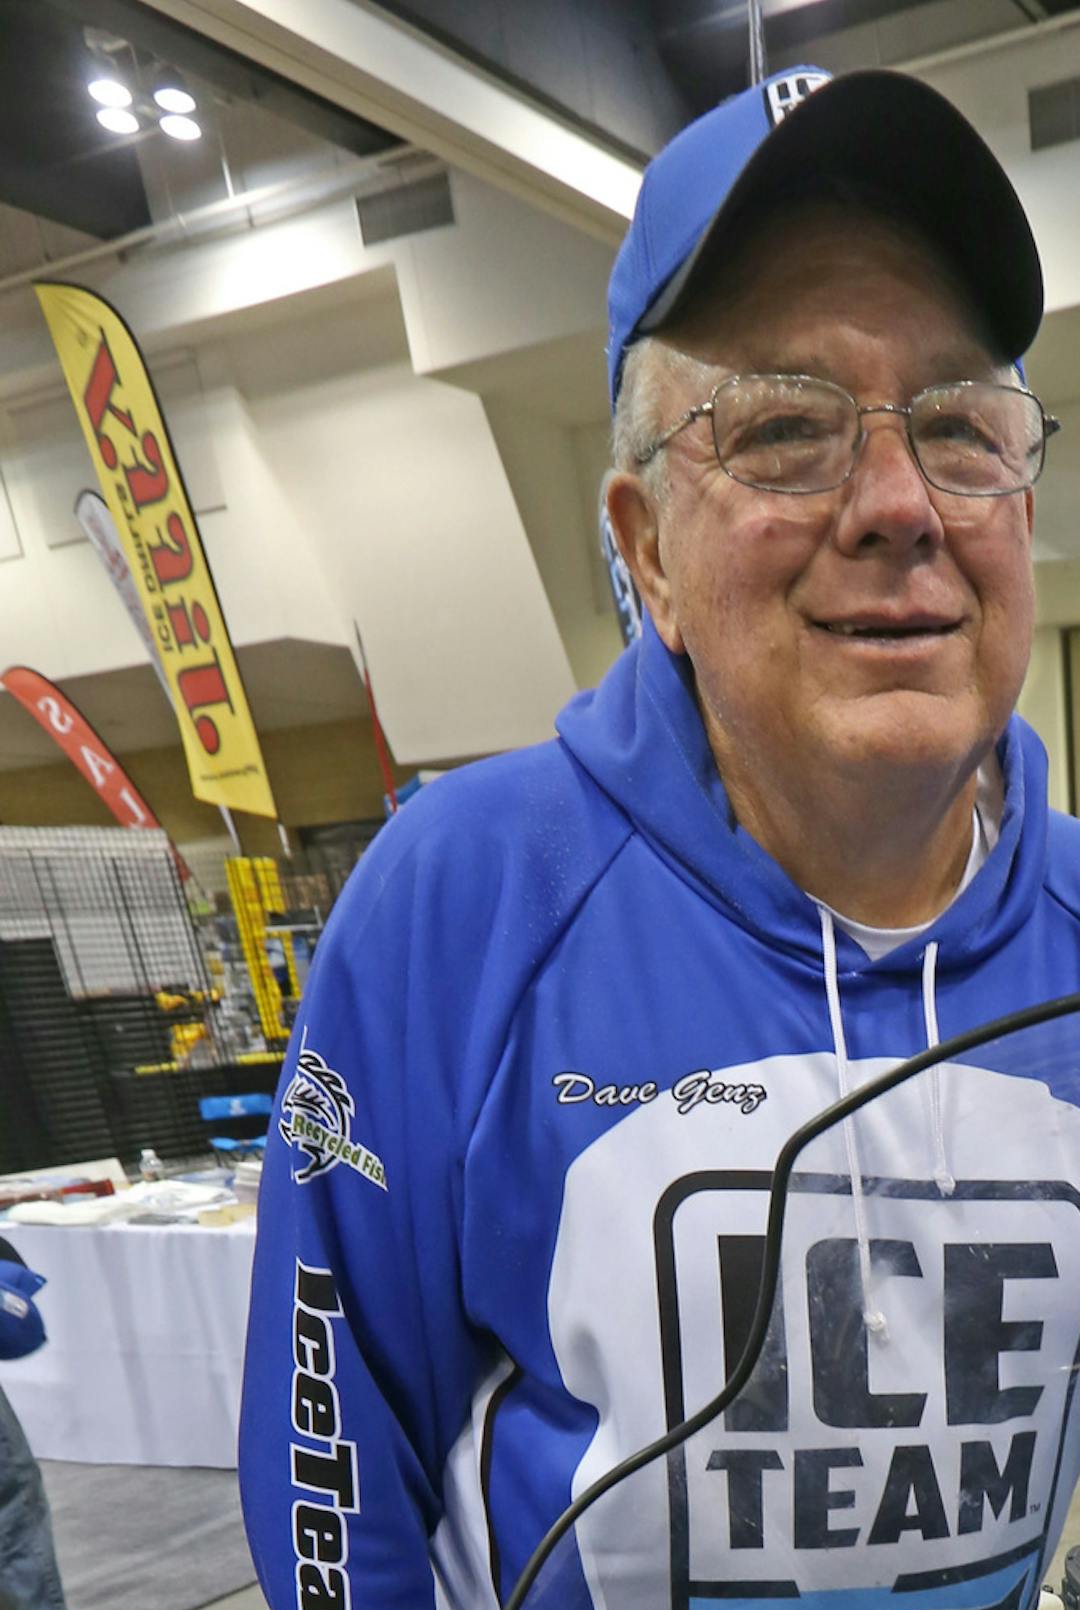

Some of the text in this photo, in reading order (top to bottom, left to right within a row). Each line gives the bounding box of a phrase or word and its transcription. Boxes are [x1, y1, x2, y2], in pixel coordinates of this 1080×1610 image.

[552, 1069, 768, 1115] Dave Genz
[293, 1112, 363, 1166] Recycled
[717, 1234, 1060, 1433] ICE
[705, 1431, 1038, 1550] TEAM
